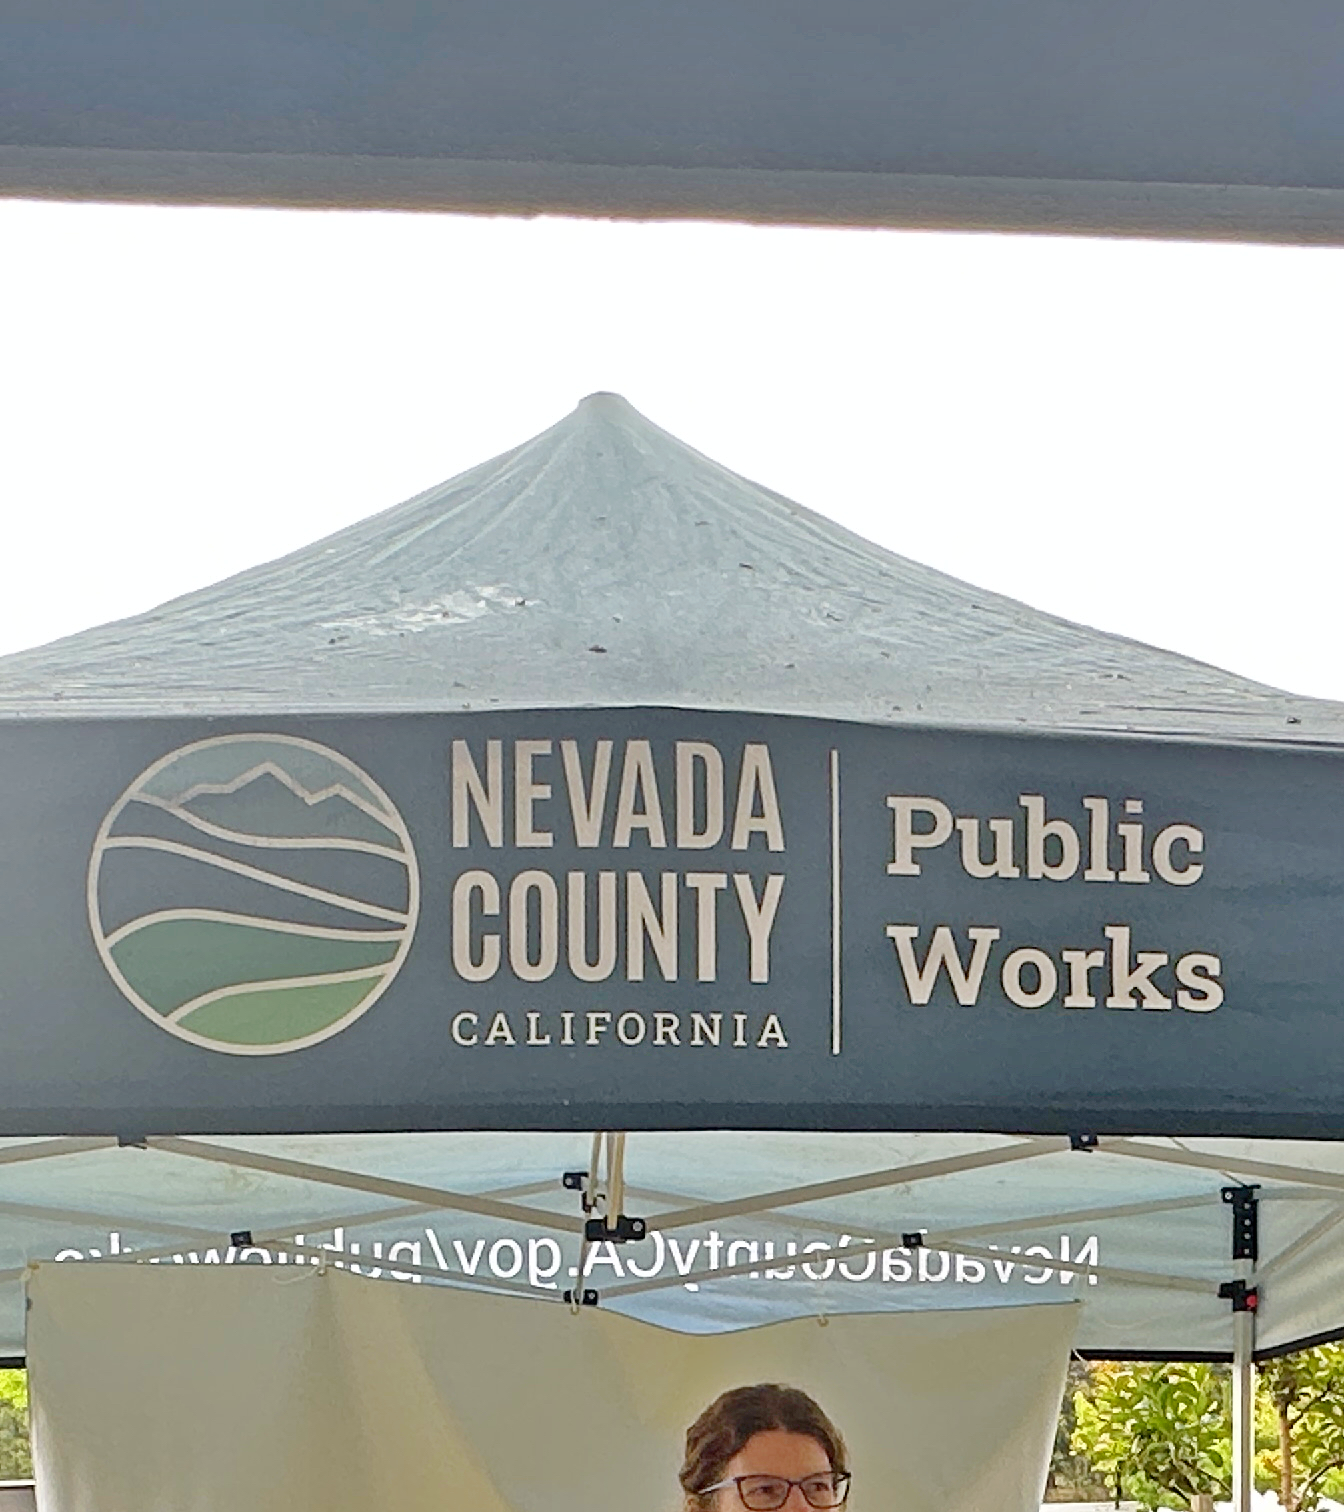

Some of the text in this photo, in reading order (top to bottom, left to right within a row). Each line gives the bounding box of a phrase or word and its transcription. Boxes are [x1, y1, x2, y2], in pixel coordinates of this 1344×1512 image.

[453, 739, 785, 852] NEVADA
[887, 795, 1203, 886] Public
[453, 870, 785, 984] COUNTY
[887, 925, 1224, 1012] Works
[453, 1012, 789, 1048] CALIFORNIA
